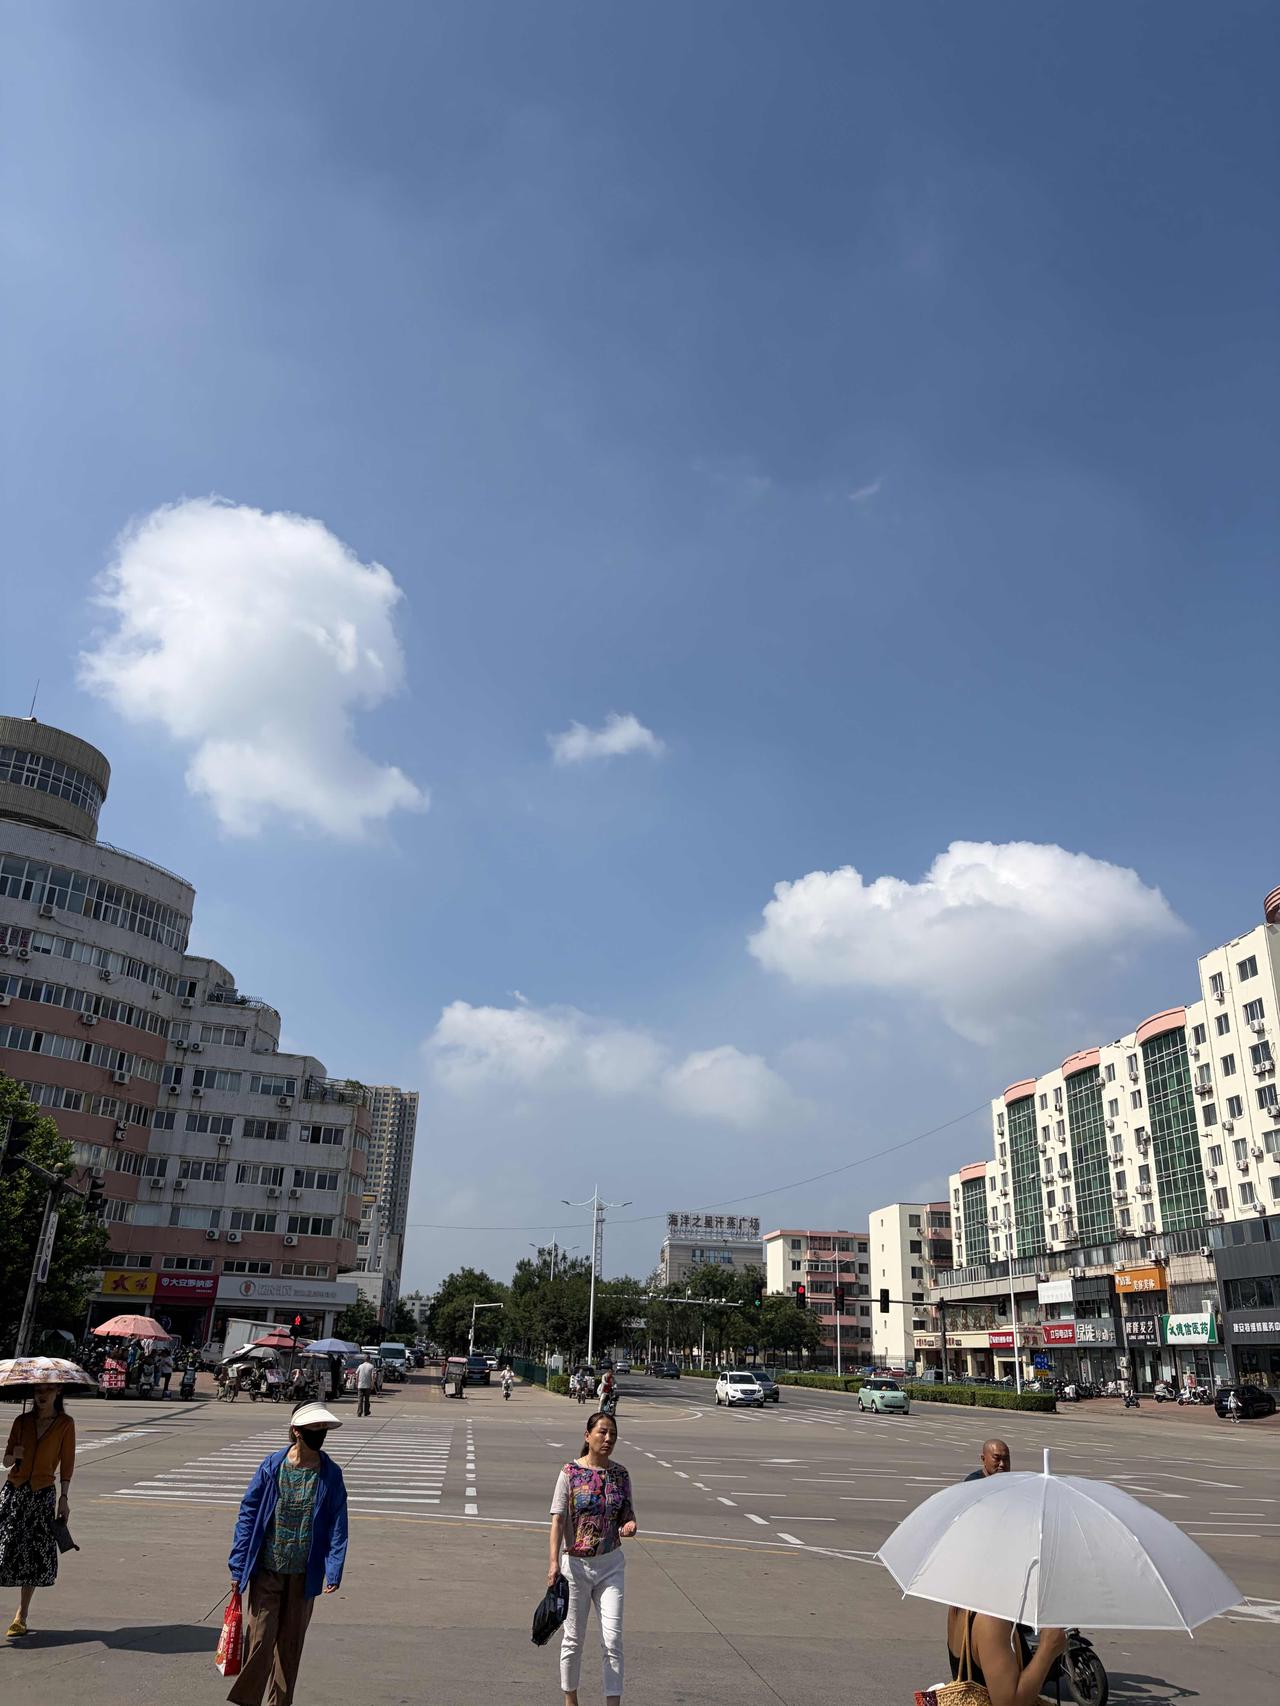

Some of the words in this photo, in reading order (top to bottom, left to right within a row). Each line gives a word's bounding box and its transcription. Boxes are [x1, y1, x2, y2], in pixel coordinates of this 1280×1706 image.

[668, 1214, 760, 1231] 海洋之星汗蒸广场
